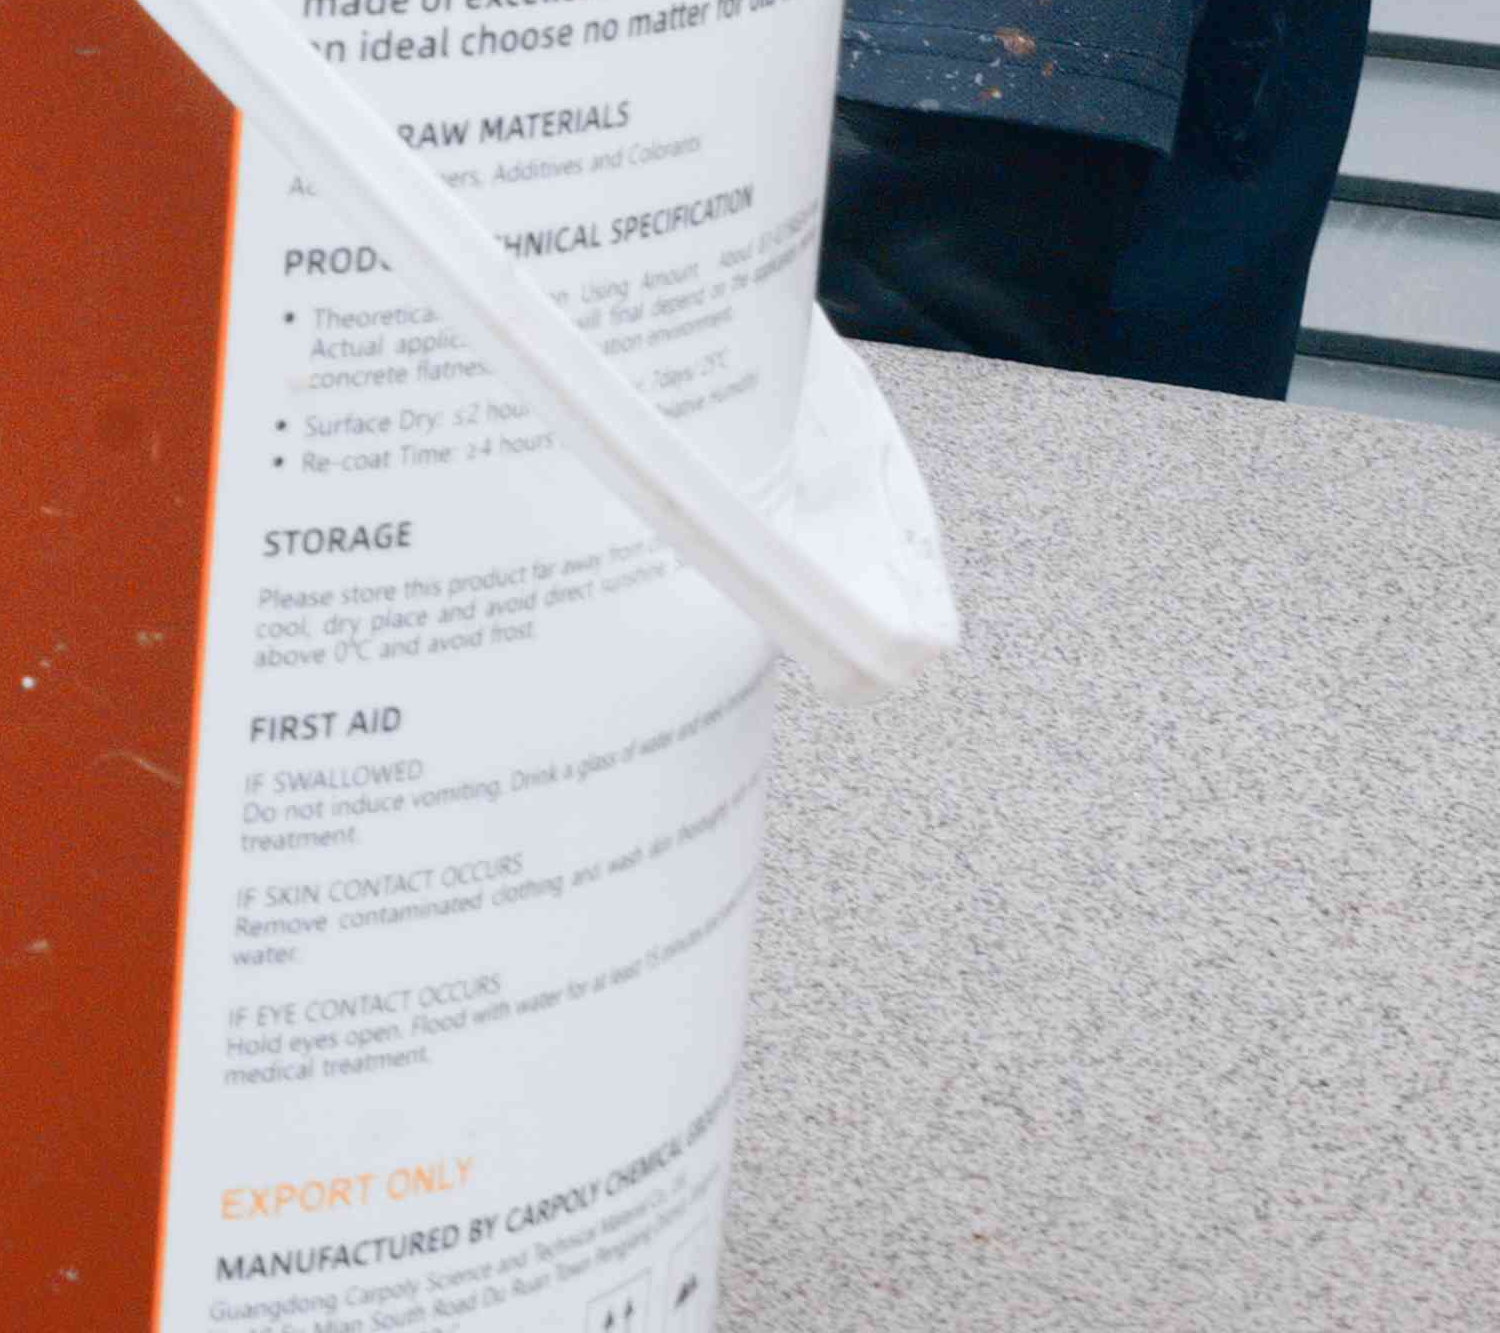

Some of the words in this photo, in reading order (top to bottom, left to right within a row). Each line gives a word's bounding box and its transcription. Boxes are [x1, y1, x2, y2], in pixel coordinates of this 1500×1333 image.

[359, 25, 450, 63] ideal
[461, 22, 574, 57] choose
[584, 16, 619, 44] no
[397, 119, 470, 150] RAW
[480, 100, 631, 144] MATERIALS
[590, 145, 624, 173] and
[494, 222, 602, 259] HNICAL
[610, 183, 755, 247] SPECIFICATION
[310, 334, 385, 361] Actual
[309, 364, 408, 390] concrete
[304, 409, 393, 438] Surface
[301, 450, 391, 474] Re-coat
[262, 520, 413, 559] STORAGE
[257, 585, 335, 610] Please
[340, 583, 398, 605] store
[404, 576, 443, 600] this
[448, 565, 528, 600] product
[371, 607, 429, 634] place
[437, 599, 477, 625] and
[486, 591, 538, 618] avoid
[253, 646, 327, 669] above
[378, 634, 421, 661] and
[427, 627, 484, 654] avoid
[250, 711, 338, 744] FIRST
[347, 706, 403, 738] AID
[244, 772, 265, 796] IF
[273, 757, 424, 795] SWALLOWED
[242, 801, 277, 825] Do
[285, 800, 324, 822] not
[332, 792, 405, 818] induce
[236, 886, 257, 910] IF
[264, 884, 321, 909] SKIN
[327, 868, 436, 904] CONTACT
[235, 915, 328, 938] Remove
[338, 891, 484, 931] contaminated
[227, 1006, 249, 1029] IF
[256, 1001, 298, 1027] EYE
[303, 989, 412, 1023] CONTACT
[226, 1034, 282, 1058] Hold
[288, 1030, 339, 1055] eyes
[222, 1057, 315, 1086] medical
[219, 1172, 377, 1222] EXPORT
[387, 1155, 476, 1202] ONLY
[215, 1222, 461, 1283] MANUFACTURED
[468, 1212, 500, 1245] BY
[504, 1179, 600, 1234] CARPOLY
[208, 1293, 339, 1323] Guangdong
